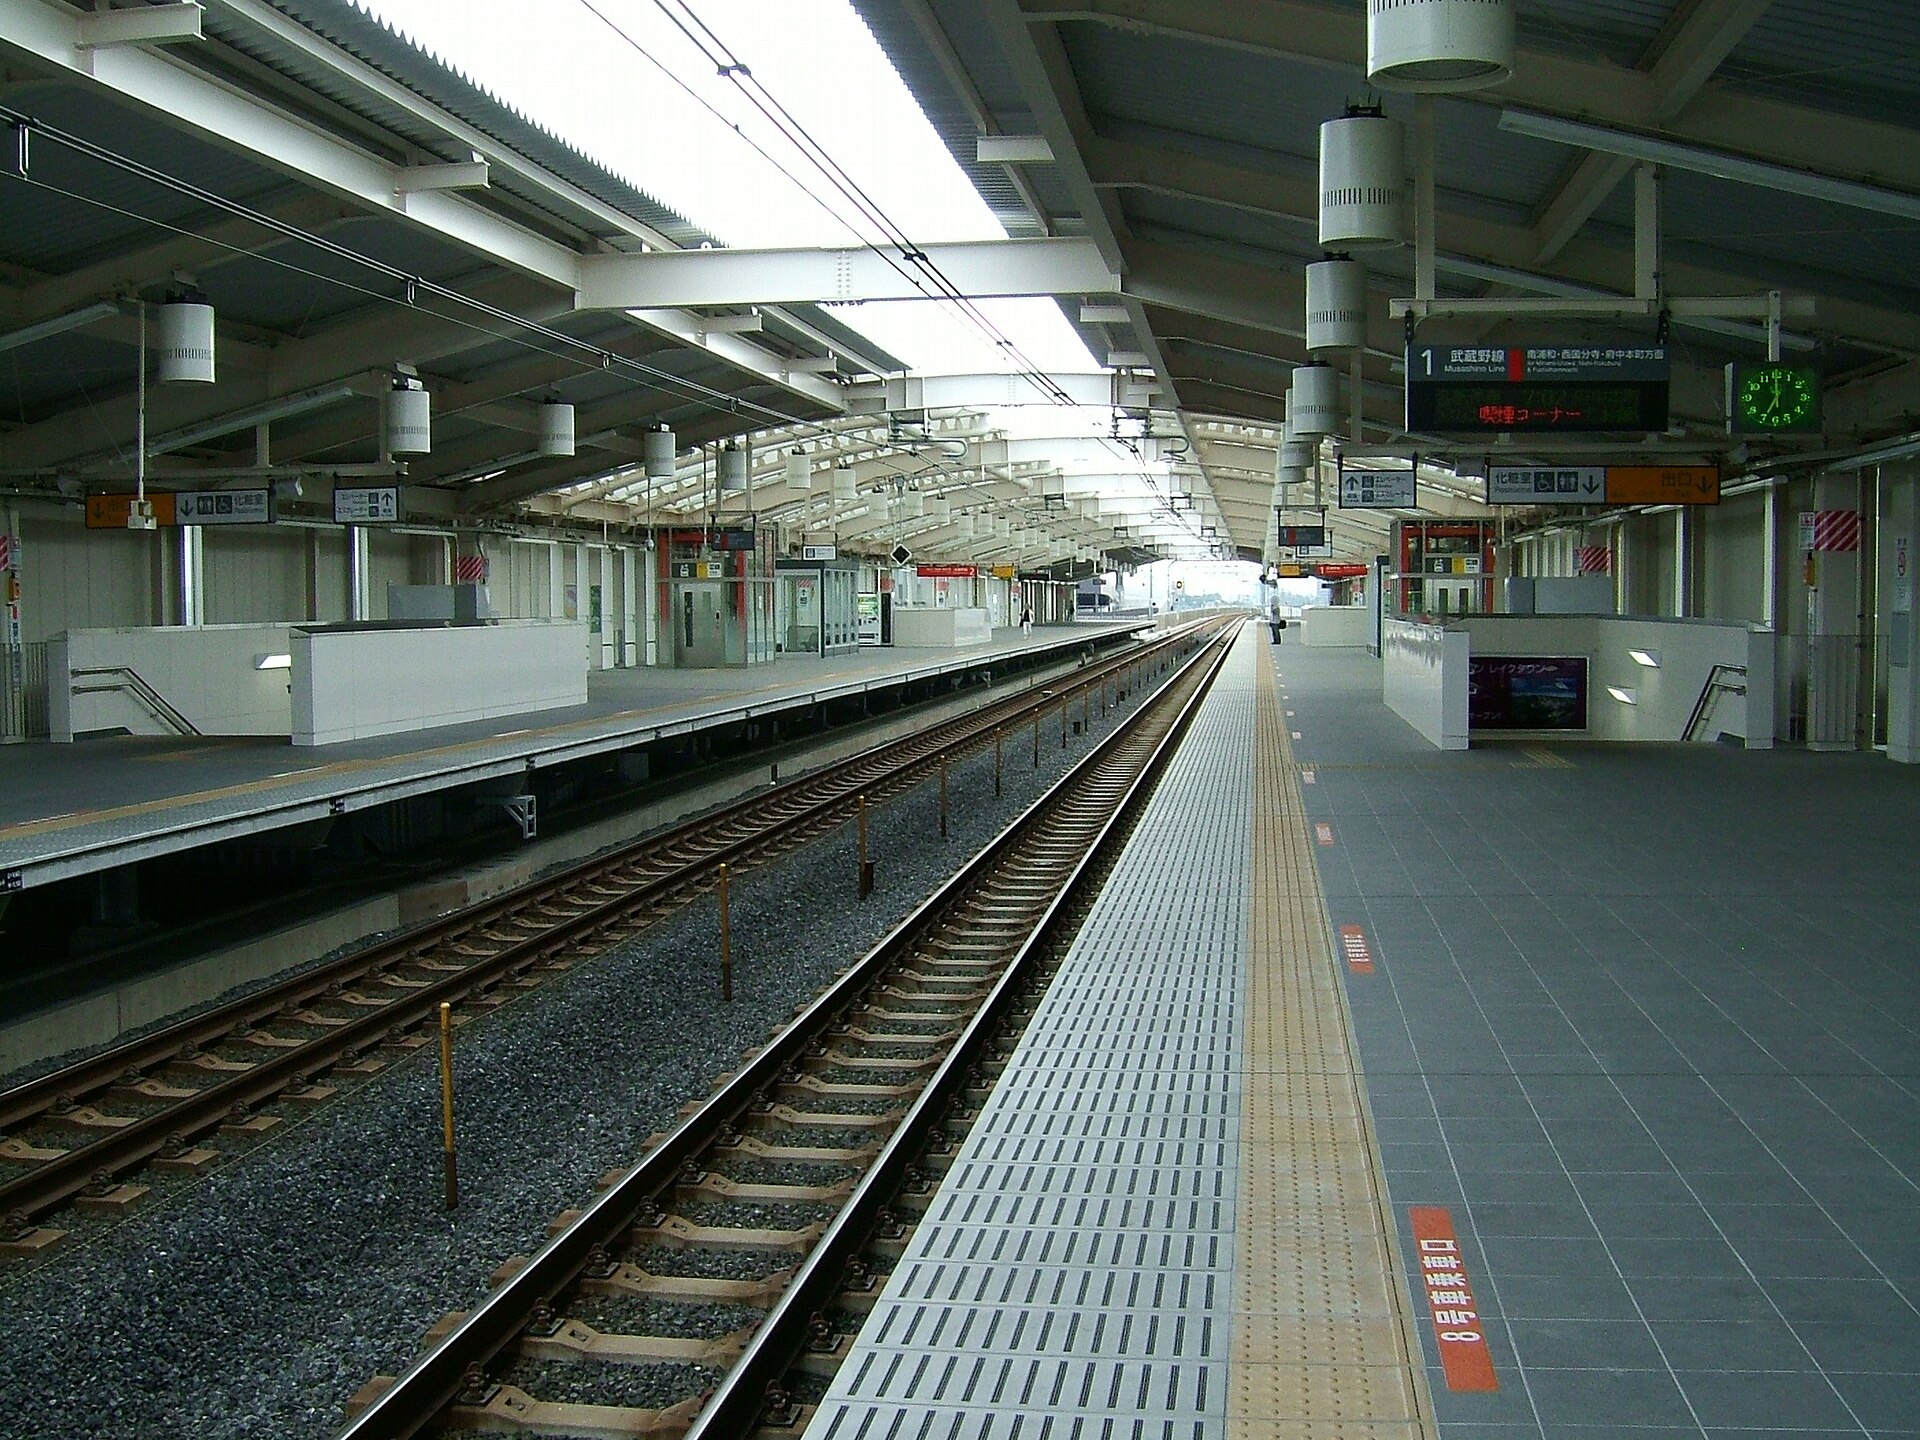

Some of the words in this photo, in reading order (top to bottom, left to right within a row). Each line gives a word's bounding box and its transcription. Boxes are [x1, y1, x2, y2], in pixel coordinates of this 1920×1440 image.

[1450, 349, 1505, 362] 武蔵野線
[1421, 349, 1432, 376] 1
[1444, 364, 1487, 373] Musashino
[1488, 364, 1506, 373] Line
[1750, 383, 1760, 391] 10
[1745, 393, 1752, 402] 9
[1800, 393, 1807, 401] 3
[1479, 405, 1581, 424] 喫煙コーナー
[1750, 406, 1757, 414] 8
[1772, 416, 1779, 424] 6
[1783, 413, 1790, 421] 5
[1496, 472, 1532, 484] 化粧室
[1661, 472, 1692, 487] 出口
[714, 533, 721, 544] 2
[969, 567, 975, 576] 2
[1420, 1240, 1481, 1342] 8号車乗車口
